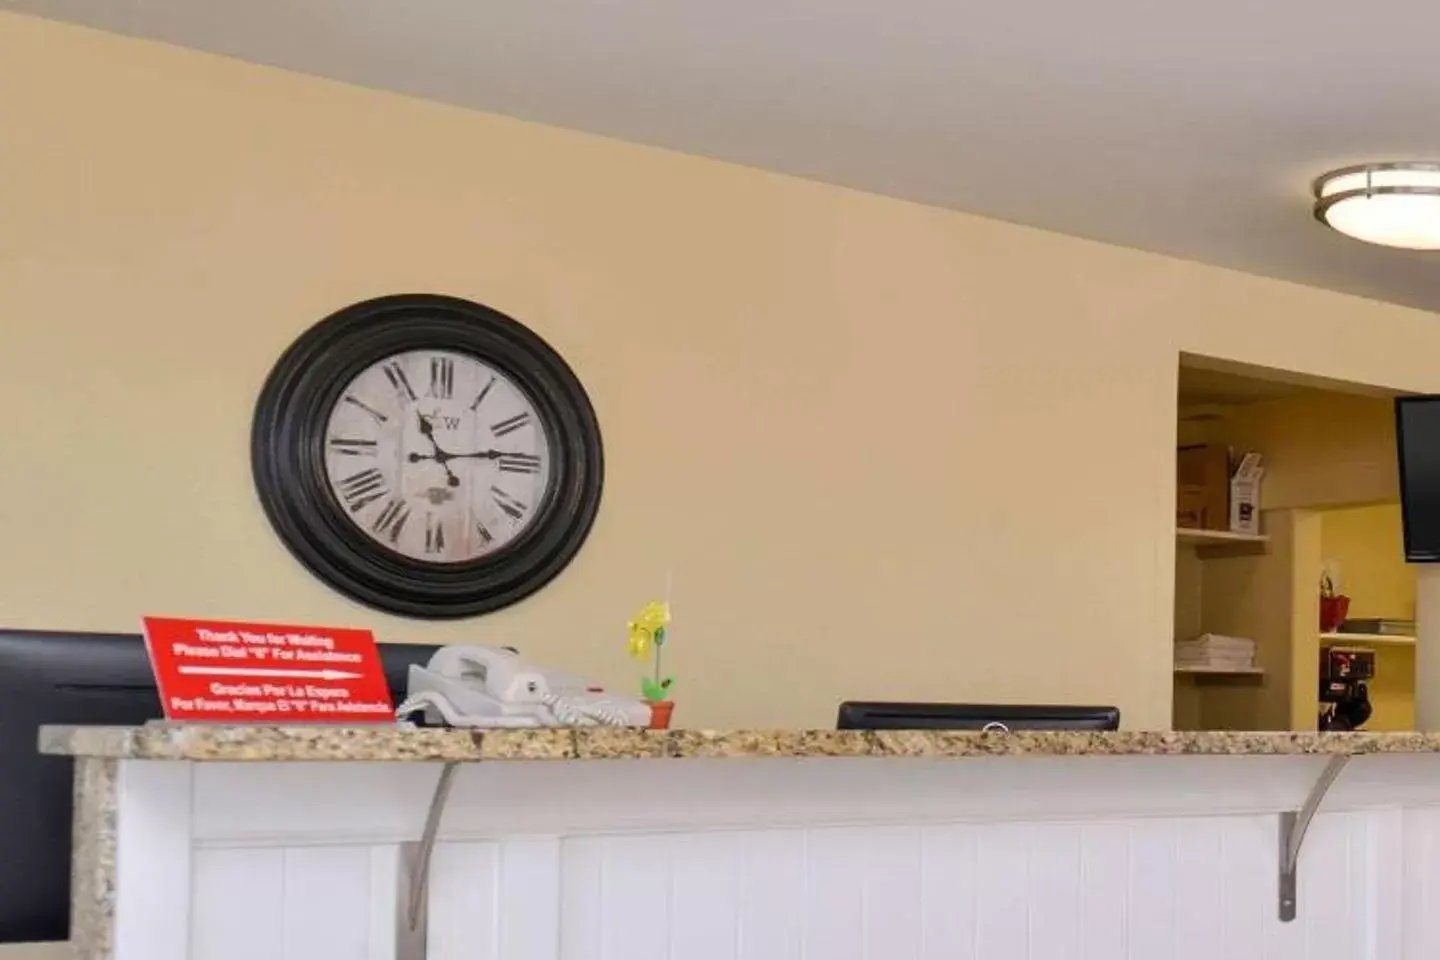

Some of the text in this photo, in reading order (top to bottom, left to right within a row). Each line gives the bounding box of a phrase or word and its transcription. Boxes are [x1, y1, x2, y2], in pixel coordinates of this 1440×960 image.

[196, 628, 240, 643] Thank
[239, 631, 266, 645] You
[172, 643, 219, 658] Please
[295, 648, 362, 663] Assistance
[209, 681, 261, 696] Gracias
